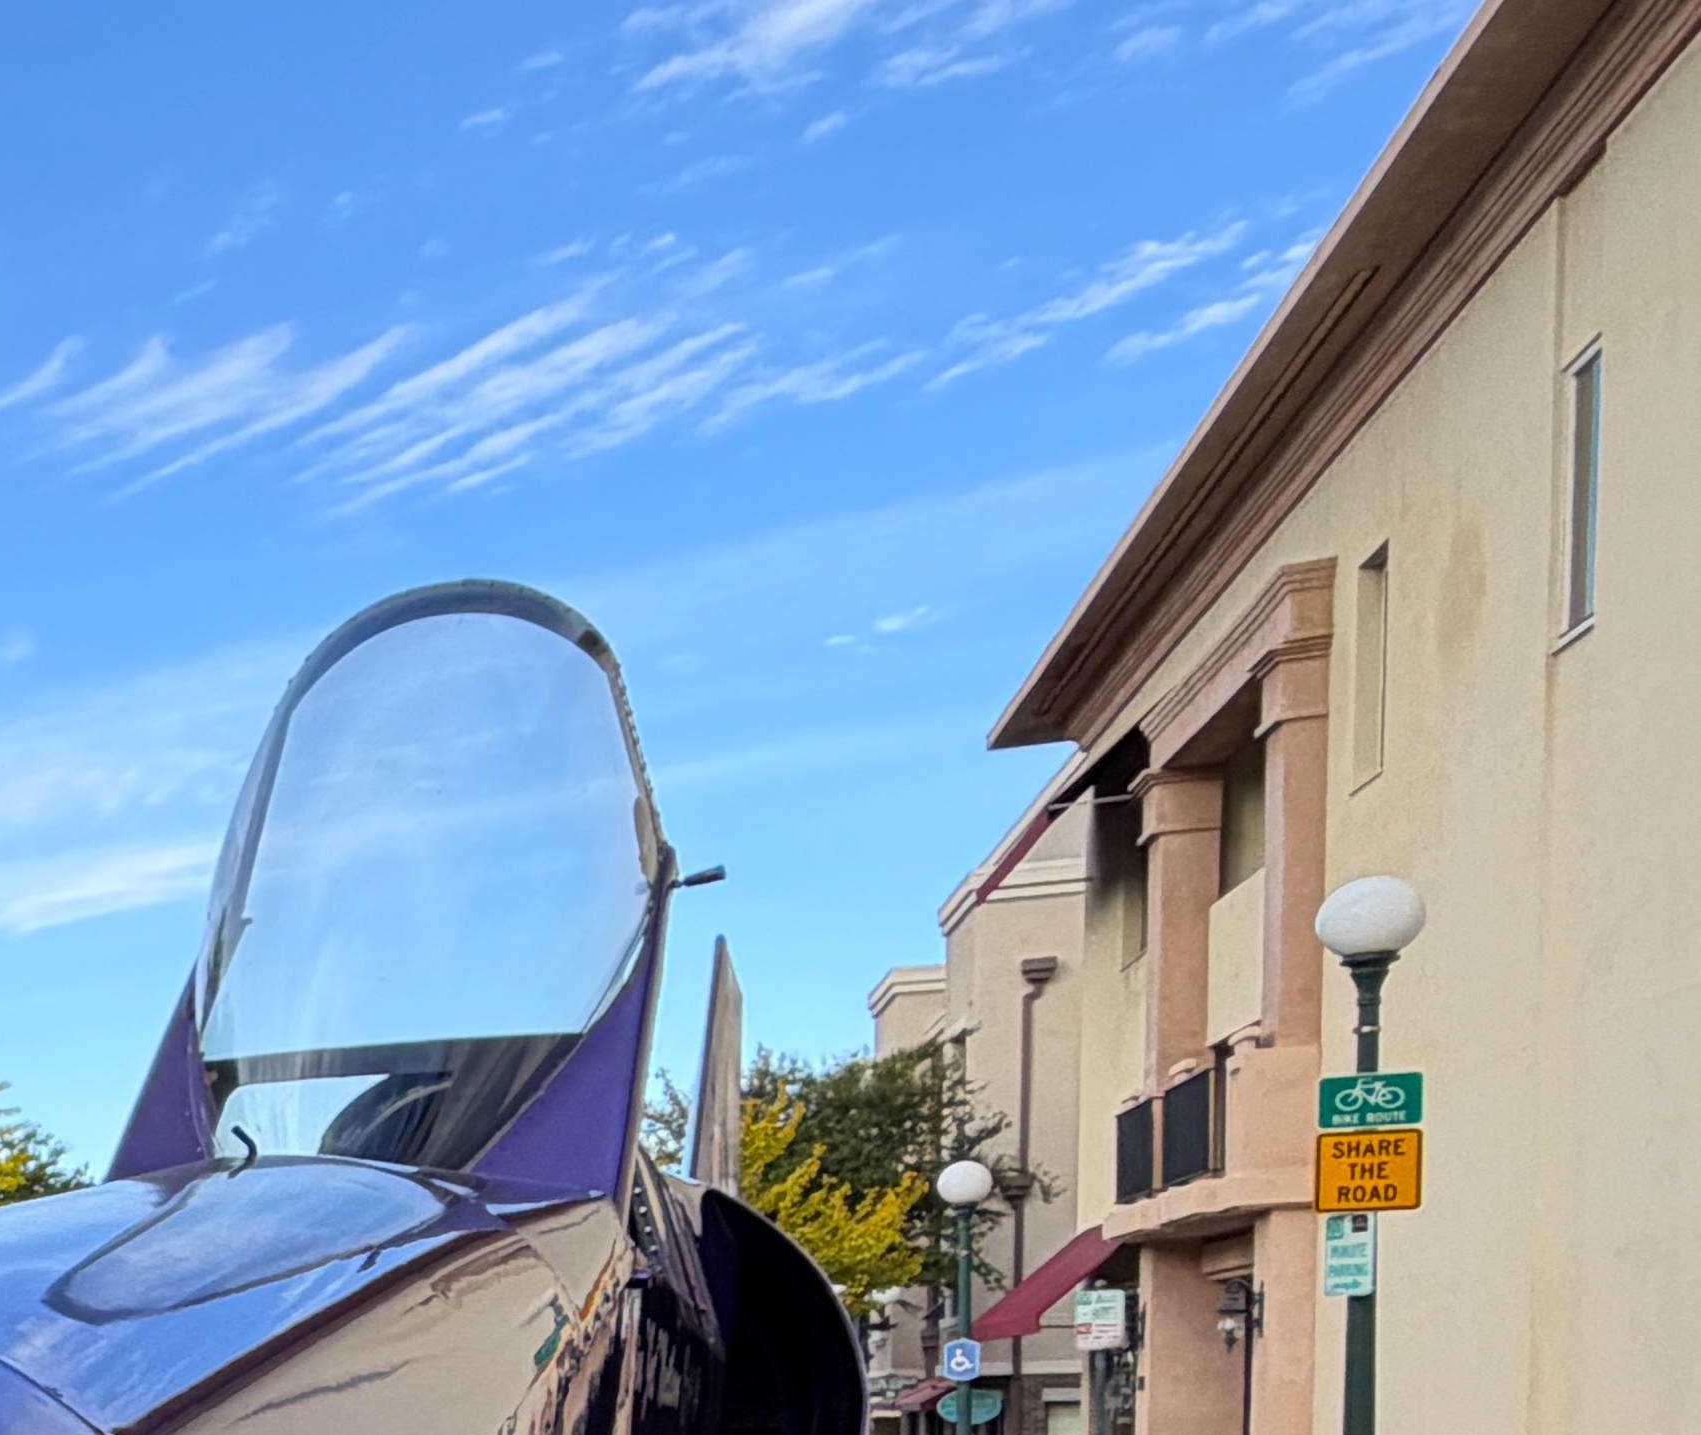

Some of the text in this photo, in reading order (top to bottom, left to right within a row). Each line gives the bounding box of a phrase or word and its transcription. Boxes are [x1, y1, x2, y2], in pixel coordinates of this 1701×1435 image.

[1332, 1138, 1406, 1159] SHARE
[1348, 1161, 1390, 1181] THE
[1337, 1183, 1398, 1203] ROAD
